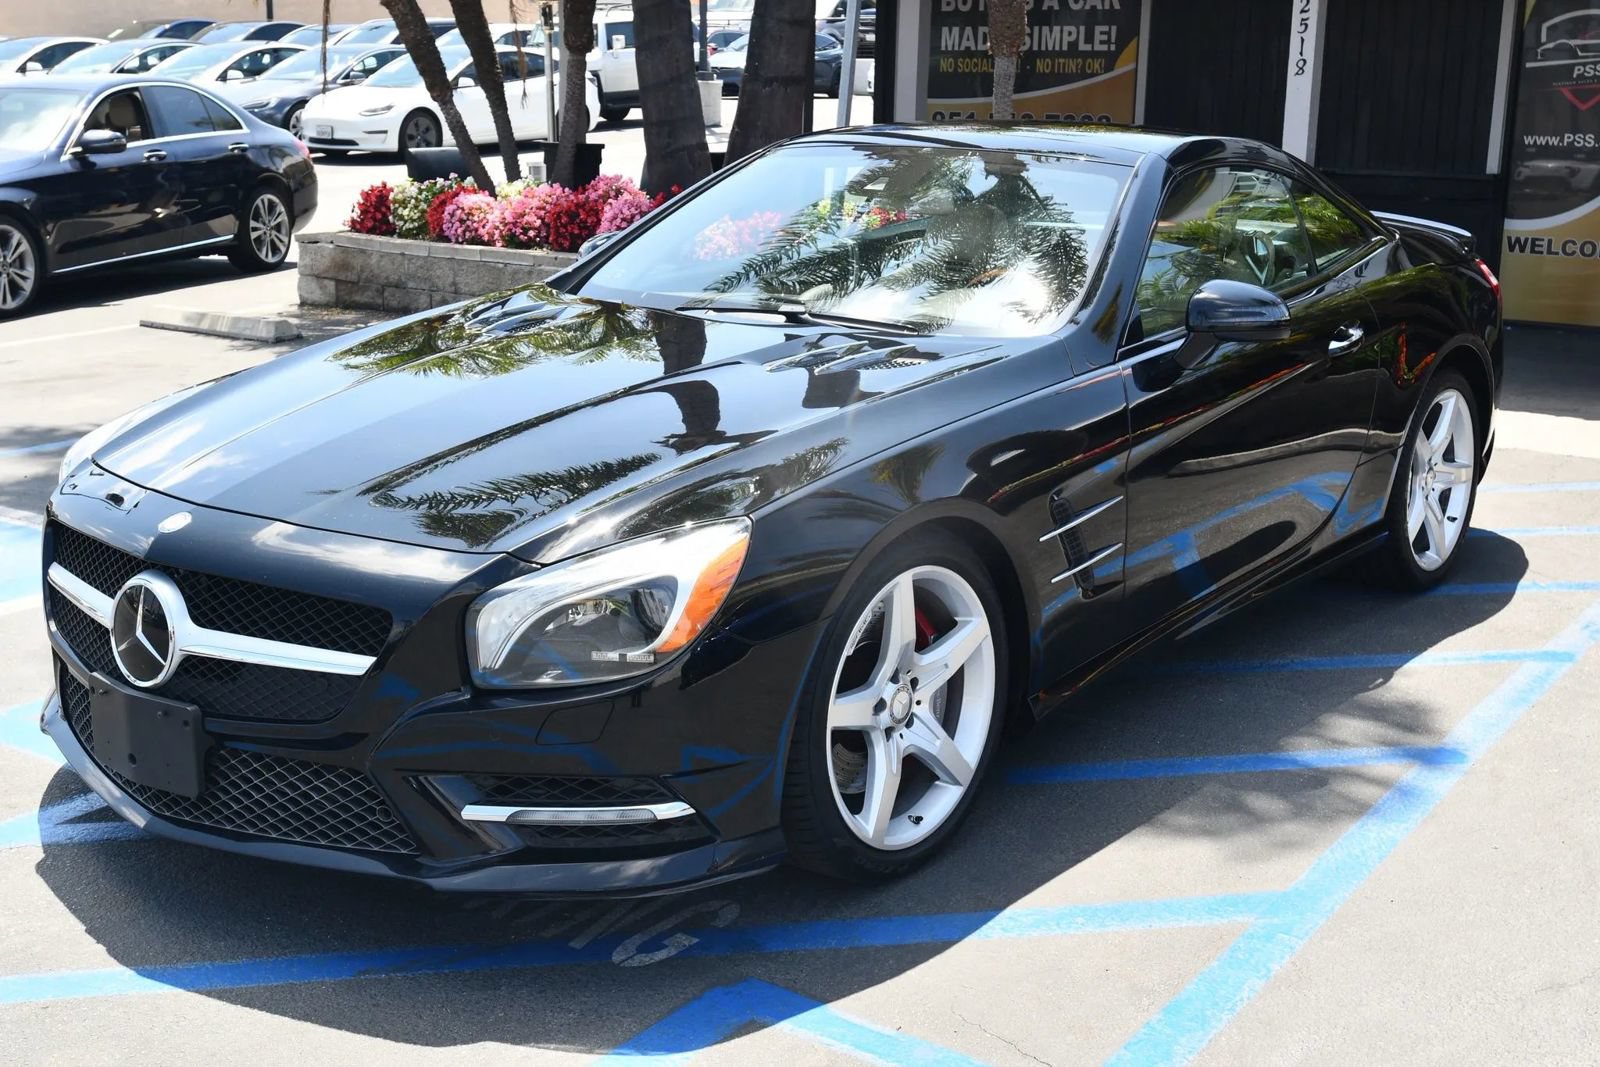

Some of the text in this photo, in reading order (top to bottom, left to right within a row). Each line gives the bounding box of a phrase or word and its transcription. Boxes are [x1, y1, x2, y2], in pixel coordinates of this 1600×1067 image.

[940, 26, 990, 51] MAD
[940, 58, 954, 73] NO
[957, 58, 995, 73] SOCIAL
[1036, 58, 1050, 73] NO
[1053, 58, 1082, 73] ITIN?
[1085, 58, 1105, 73] OK!
[1523, 133, 1600, 148] www.PSS.
[1507, 235, 1600, 258] WELCO
